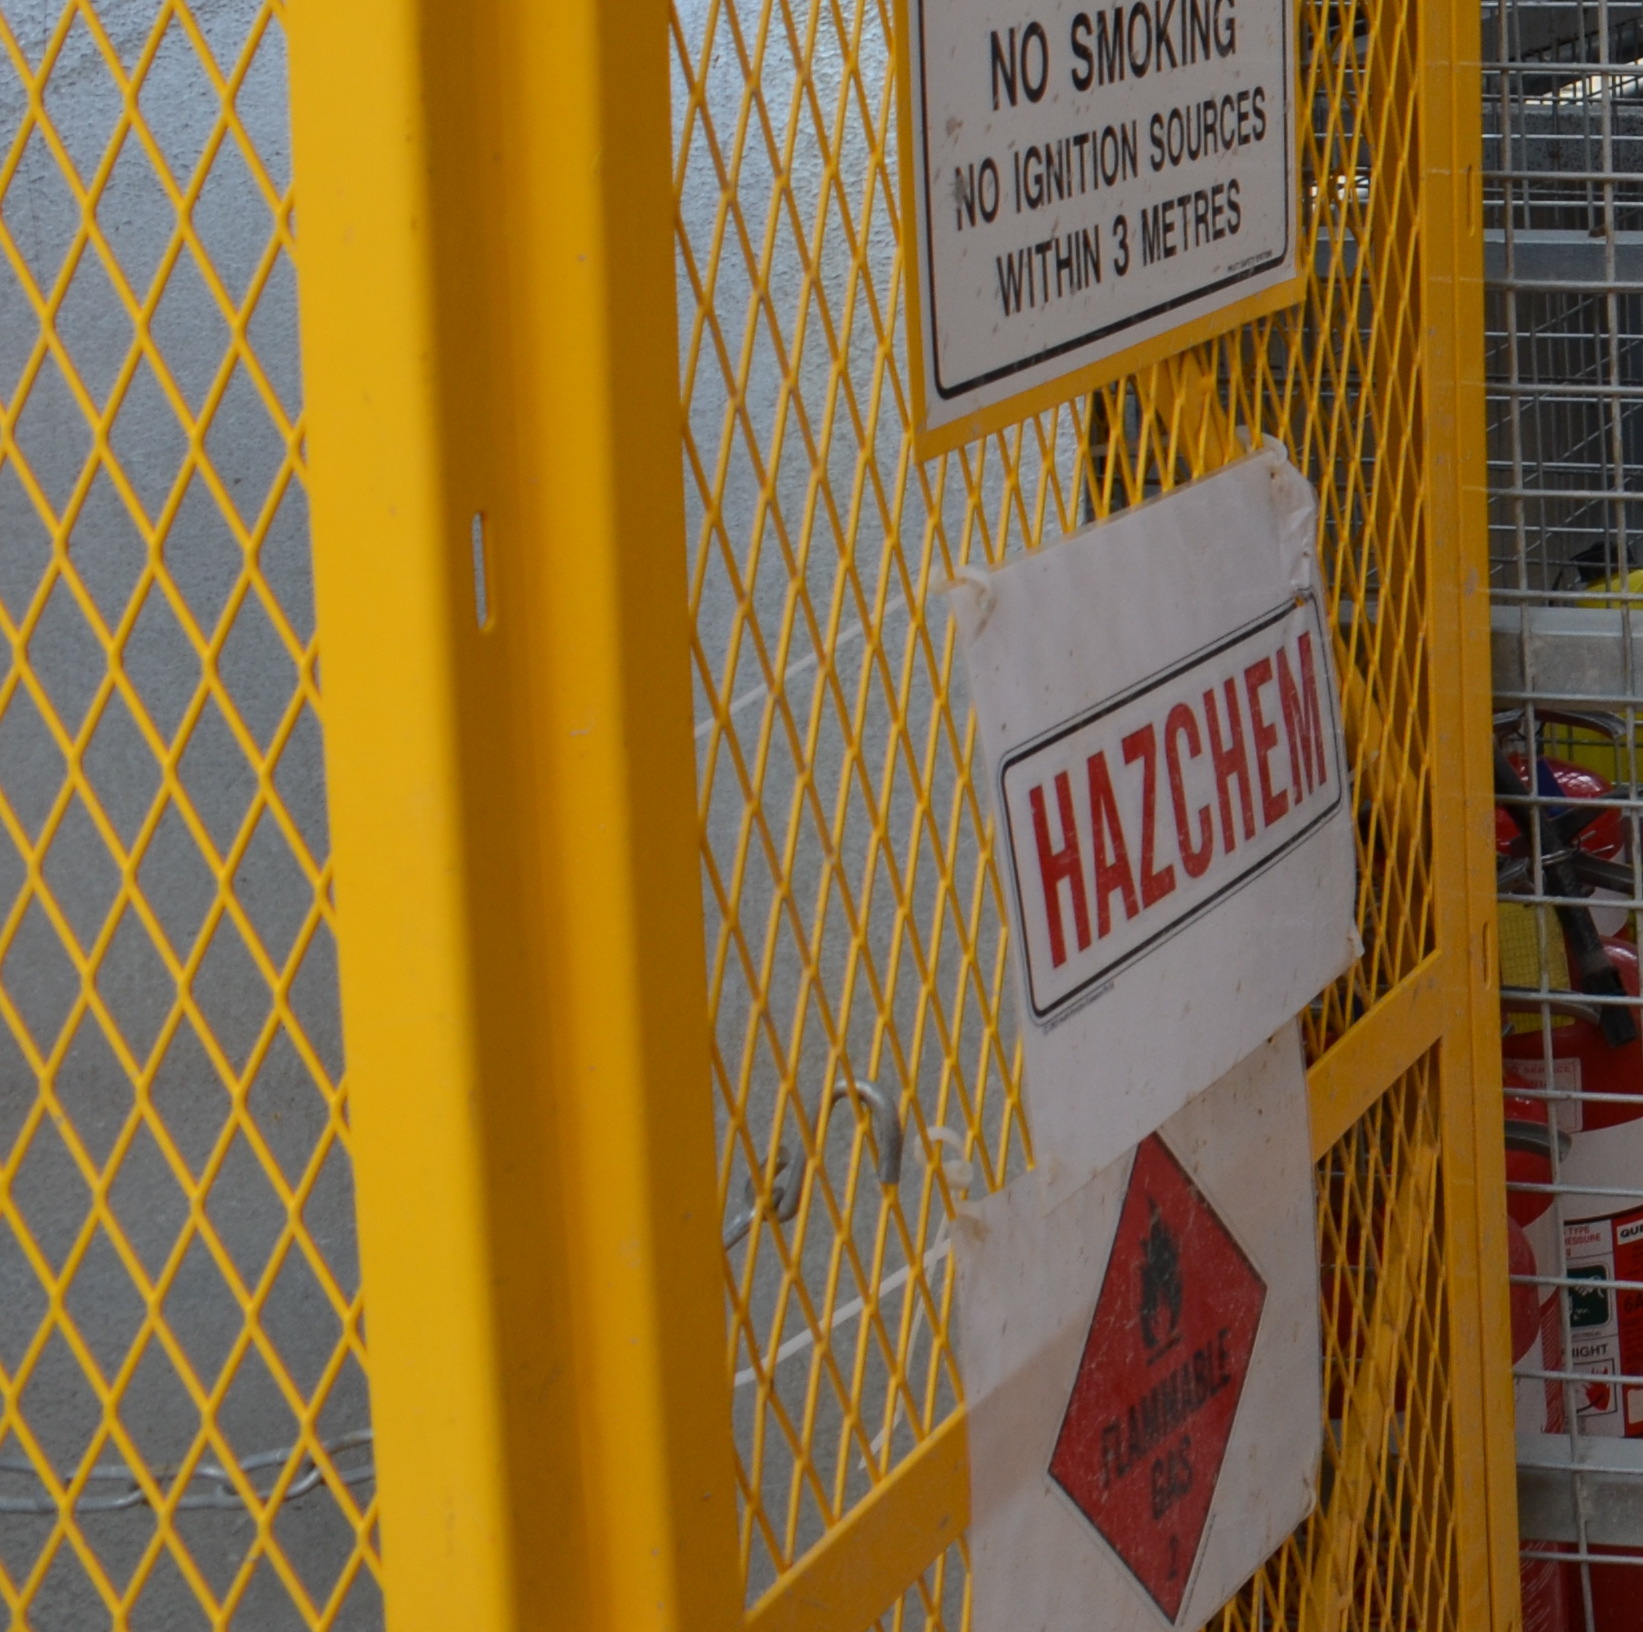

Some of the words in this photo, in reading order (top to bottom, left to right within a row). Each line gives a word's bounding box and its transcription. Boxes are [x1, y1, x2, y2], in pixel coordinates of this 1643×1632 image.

[990, 20, 1050, 112] NO
[956, 156, 1000, 232] NO
[1014, 119, 1138, 214] IGNITION
[1150, 85, 1267, 173] SOURCES
[996, 223, 1102, 317] WITHIN
[1112, 214, 1130, 277] 3
[1141, 178, 1242, 268] METRES
[1029, 630, 1327, 970] HAZCHEM
[1568, 1225, 1590, 1237] TYPE
[1102, 1327, 1231, 1490] FLAMMABLE
[1153, 1435, 1193, 1521] GAS
